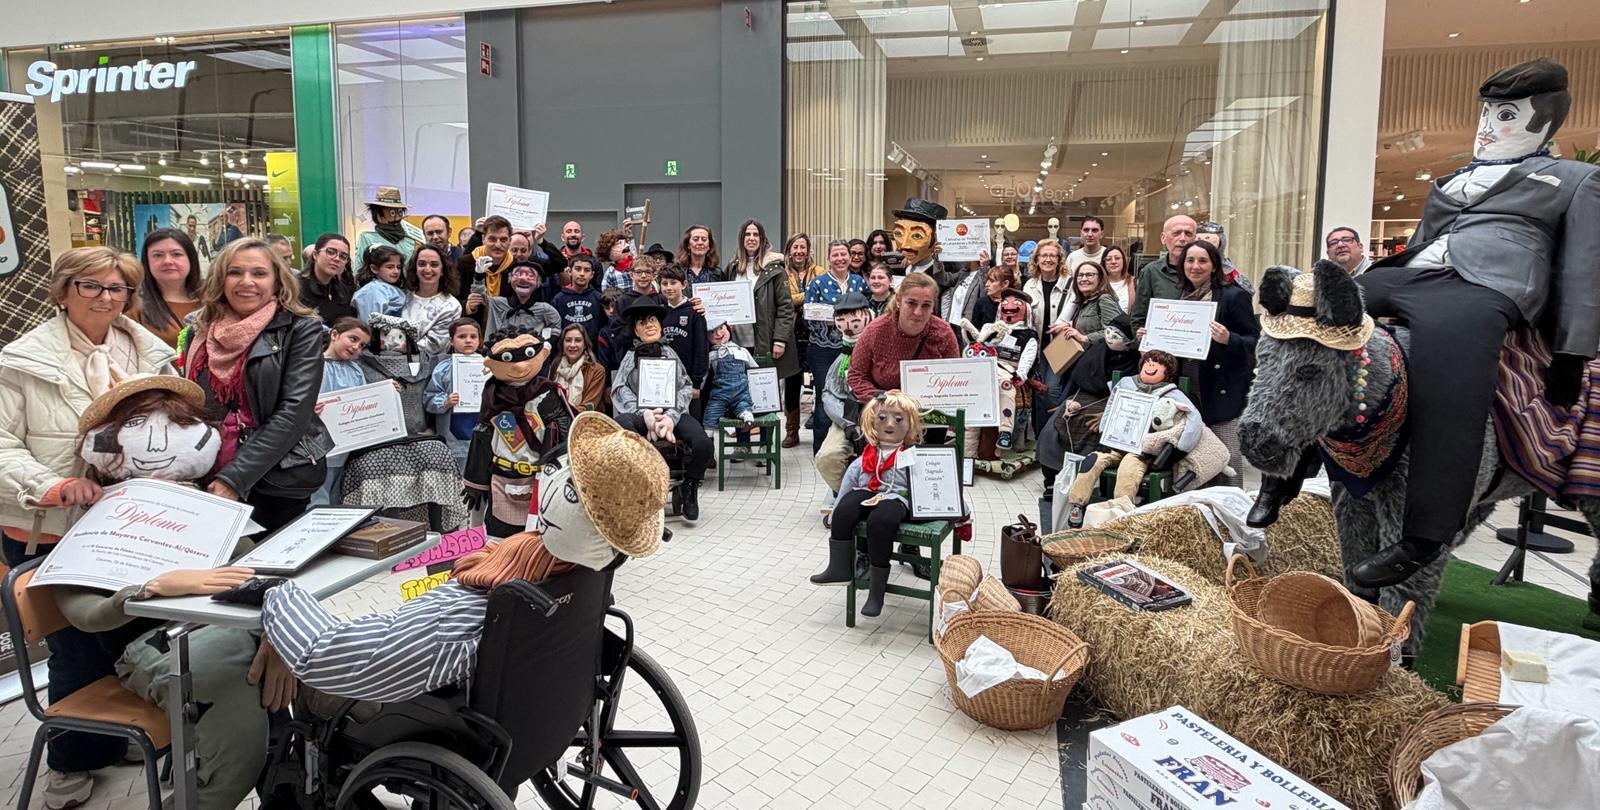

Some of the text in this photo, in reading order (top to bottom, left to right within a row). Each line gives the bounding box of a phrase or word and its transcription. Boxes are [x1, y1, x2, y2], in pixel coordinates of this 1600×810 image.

[25, 56, 197, 103] Sprinter
[566, 300, 592, 308] COLEGIO
[710, 292, 737, 304] Diploma
[1165, 313, 1194, 327] Diploma
[927, 375, 969, 394] Diploma
[341, 400, 378, 419] Diploma
[106, 502, 188, 533] Diploma
[109, 530, 138, 540] Mayores
[1171, 711, 1249, 763] PASTELERIA
[1249, 760, 1263, 777] Y
[1153, 755, 1240, 807] FRAN
